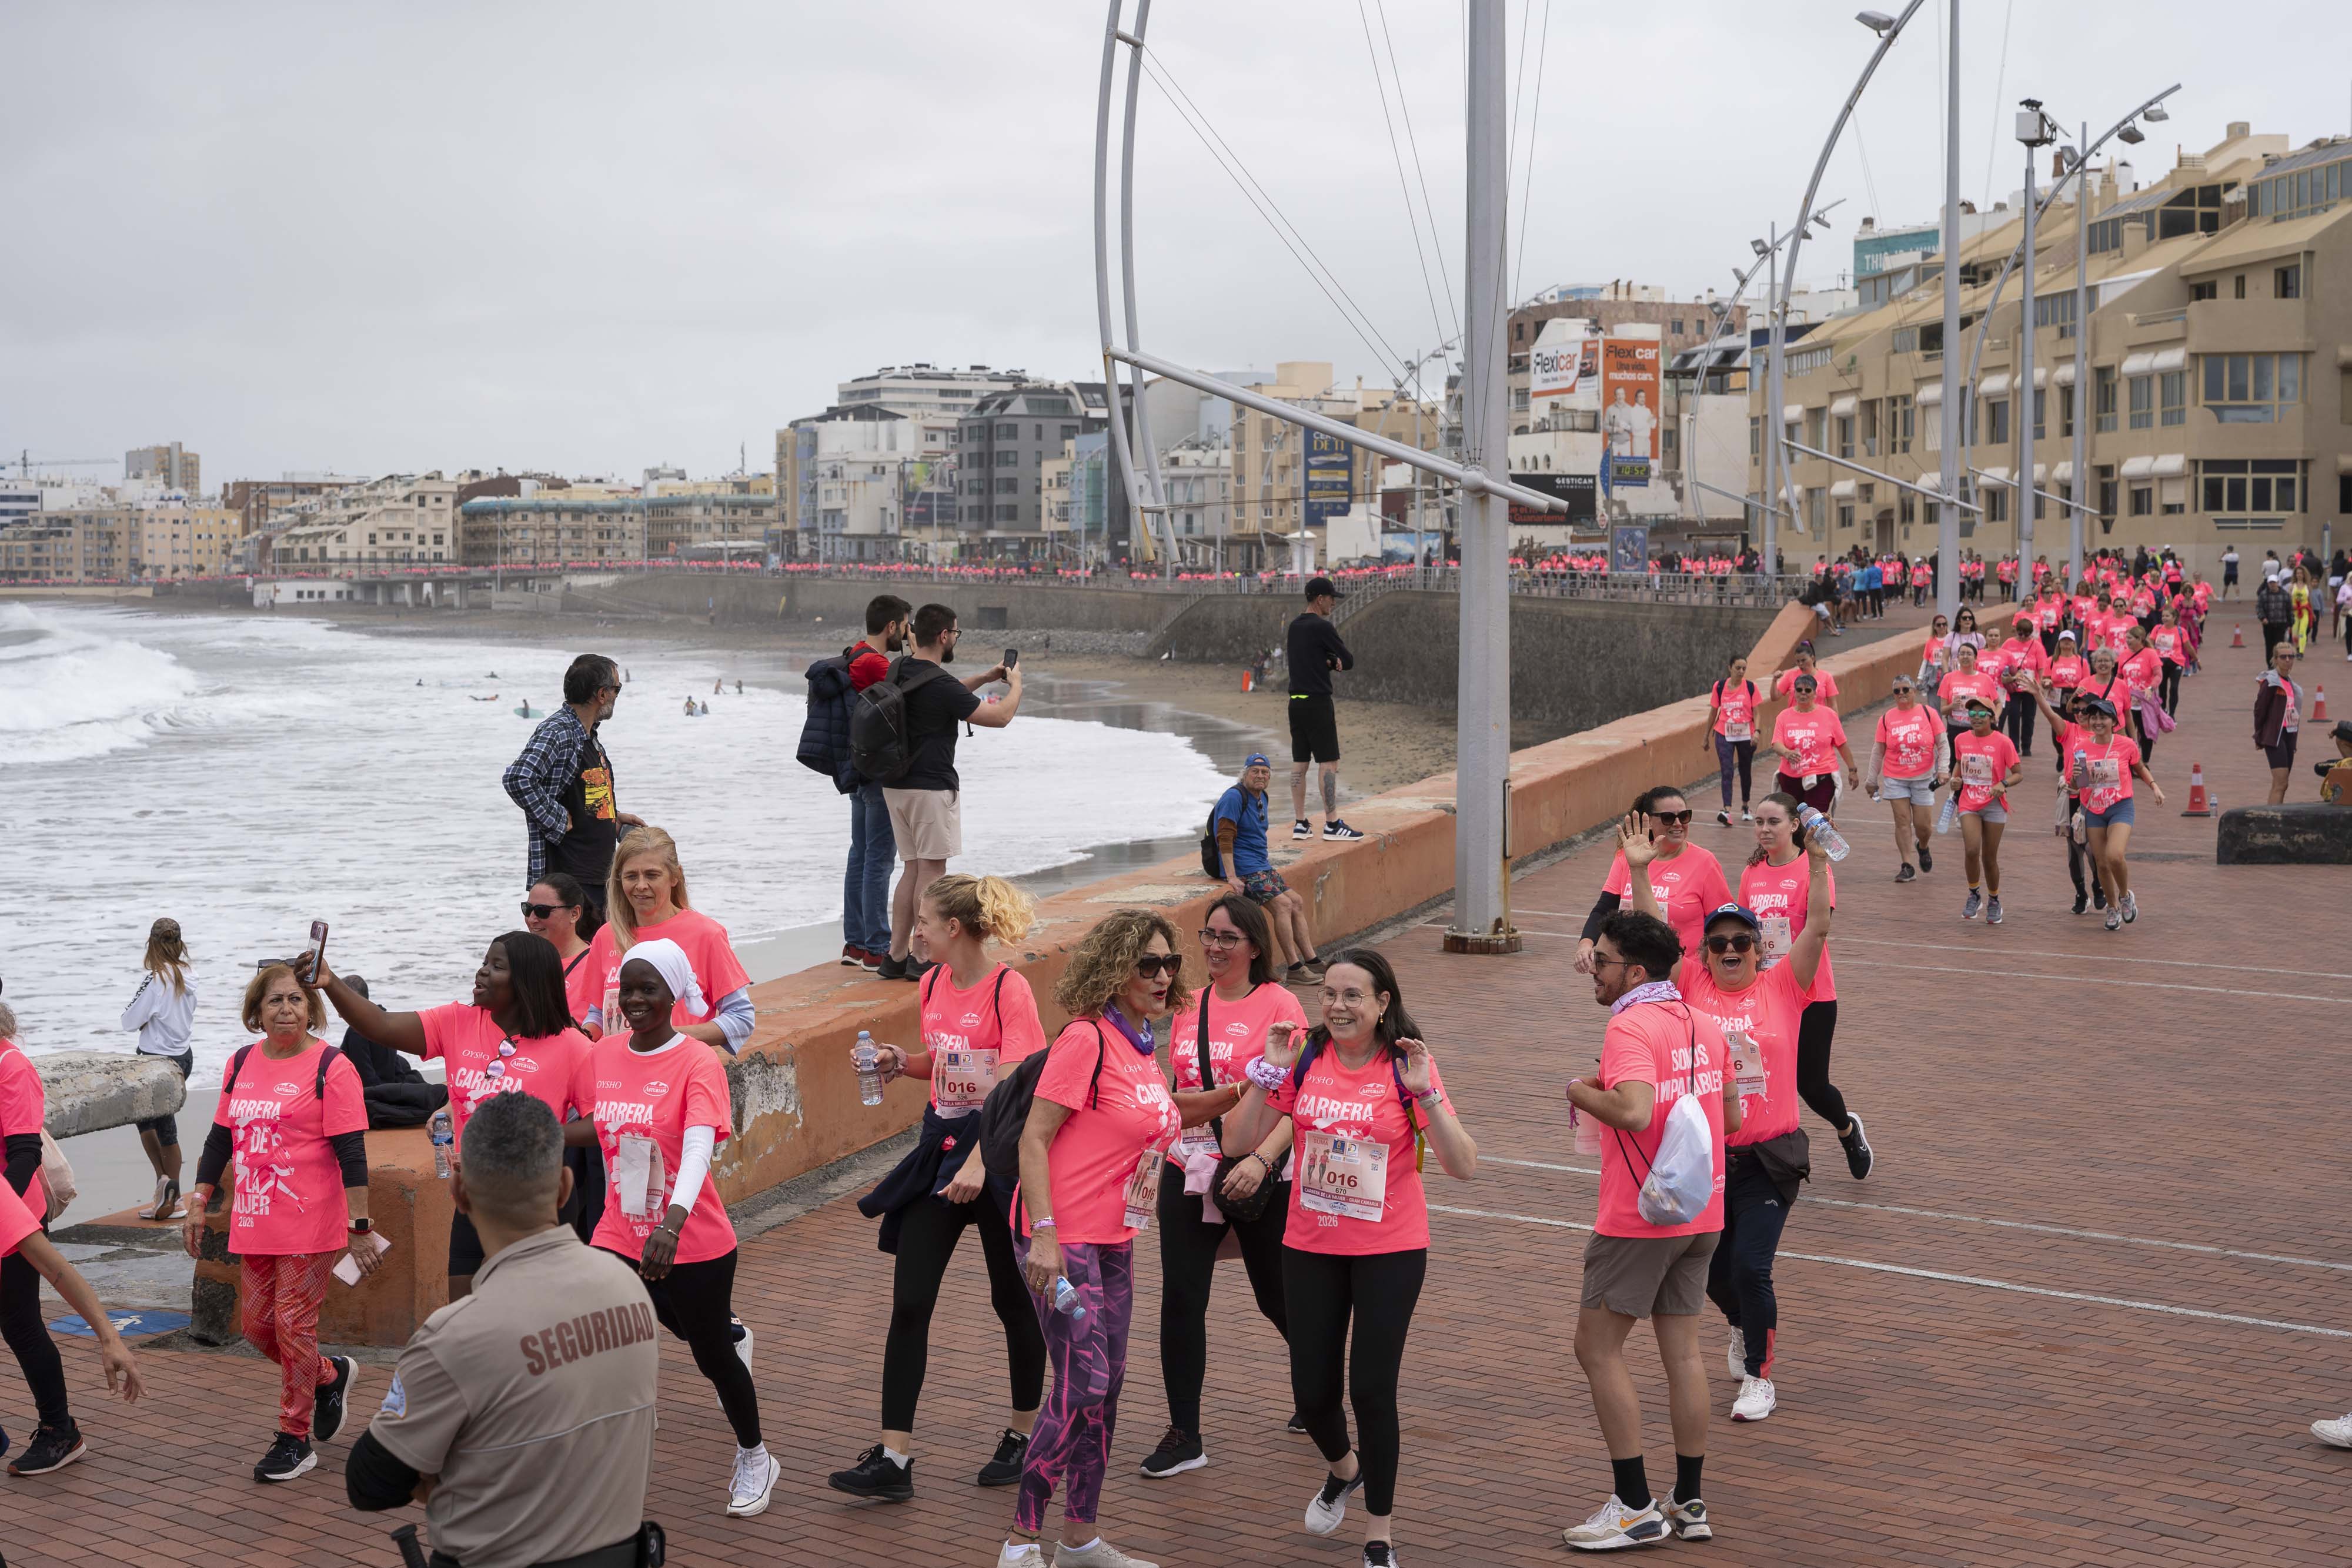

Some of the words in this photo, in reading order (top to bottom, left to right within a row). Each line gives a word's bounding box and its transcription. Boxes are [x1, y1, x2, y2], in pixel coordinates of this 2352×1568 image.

[1865, 252, 1889, 271] THI
[1605, 345, 1658, 360] Flexicar
[1534, 350, 1578, 375] Flexicar
[1616, 362, 1630, 371] Una
[1609, 371, 1636, 380] muchos
[1314, 440, 1329, 452] DE
[1621, 465, 1646, 476] 10:52
[1788, 729, 1816, 737] CARRERA
[1892, 723, 1920, 735] CARRERA
[1907, 733, 1917, 744] DE
[1623, 883, 1669, 899] CAERA
[1749, 894, 1788, 908] CARRERA
[1763, 941, 1775, 949] 16
[462, 1049, 490, 1061] OYSHO
[1177, 1039, 1234, 1061] CAERA
[1672, 1044, 1709, 1072] SOMOS
[455, 1067, 523, 1094] CARRERA
[597, 1081, 622, 1089] OYSHO
[948, 1082, 976, 1094] 016
[593, 1101, 653, 1125] CARRERA
[1297, 1094, 1374, 1122] CARRERA
[250, 1126, 268, 1154] DE
[246, 1168, 260, 1193] LA
[1327, 1171, 1358, 1188] 016
[1142, 1186, 1155, 1201] 016
[1304, 1187, 1320, 1196] CARRERA
[1361, 1199, 1379, 1207] CANARIA
[238, 1216, 254, 1228] 2026
[1317, 1215, 1338, 1227] 2026
[520, 1301, 655, 1376] SEGURIDAD
